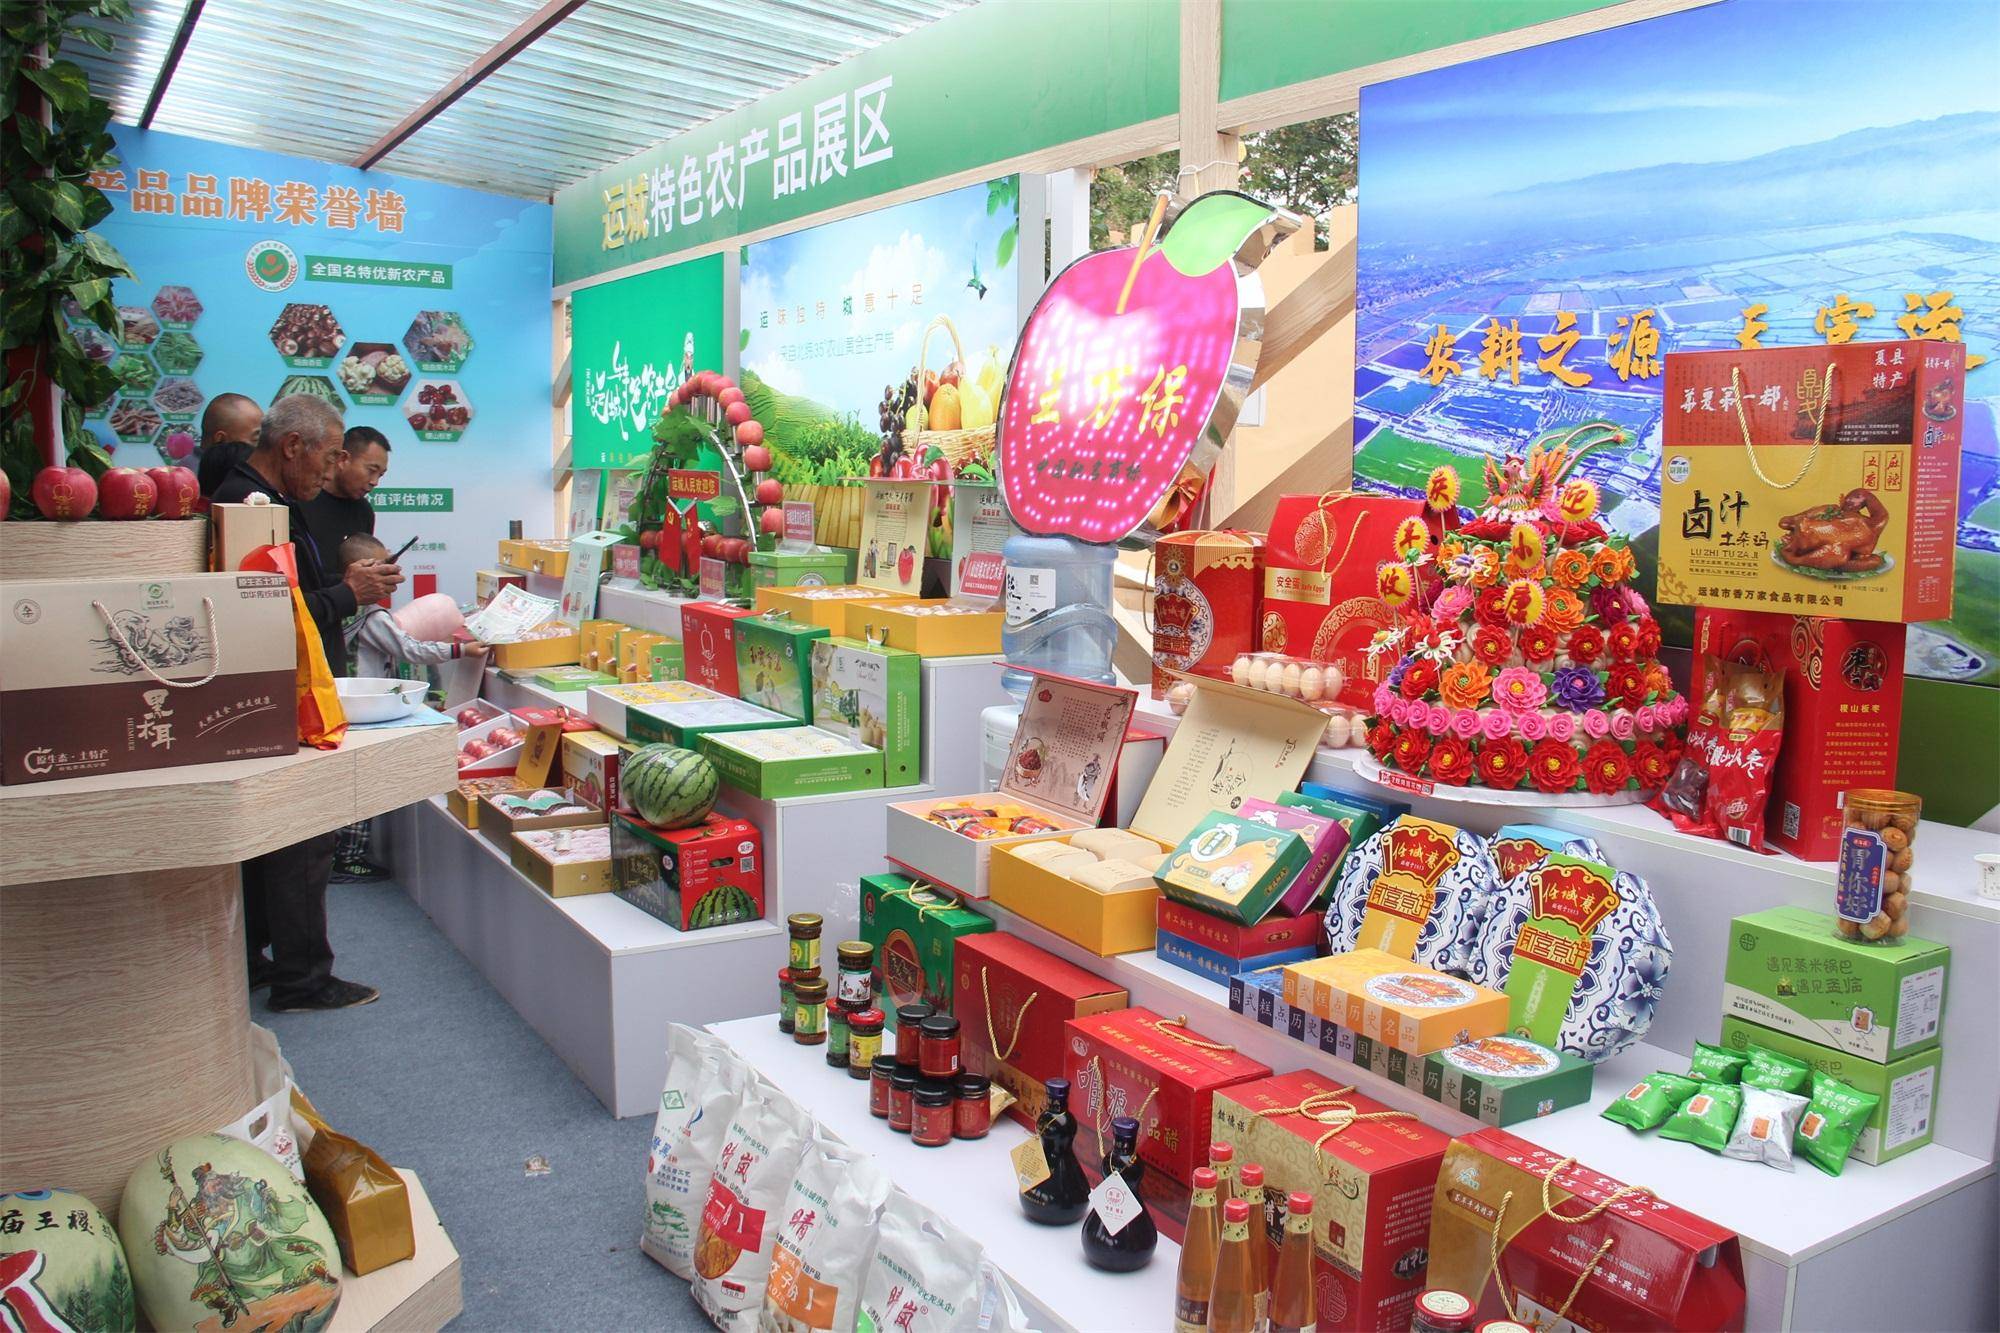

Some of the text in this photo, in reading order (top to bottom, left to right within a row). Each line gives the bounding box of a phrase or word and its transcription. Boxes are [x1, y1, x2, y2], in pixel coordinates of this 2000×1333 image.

[602, 75, 893, 250] 运城特色农产品展区
[311, 261, 446, 284] 全国名特优新农产品
[1419, 310, 1660, 387] 农耕之源
[1874, 348, 1905, 366] 夏县
[1873, 371, 1904, 389] 特产
[672, 476, 716, 494] 运城人民欢迎您
[1682, 490, 1749, 540] 卤汁
[1690, 548, 1701, 556] LU
[1703, 549, 1719, 557] ZHI
[1722, 550, 1735, 558] TU
[1751, 551, 1759, 559] JI
[1697, 586, 1843, 606] 运城市香万家食品有限公司
[1839, 704, 1881, 713] 稷山板枣
[1543, 881, 1596, 914] 任诚意
[1230, 985, 1352, 1051] 国式糕点历史名品
[1284, 978, 1416, 1043] 国式糕点历史名品
[1356, 1039, 1499, 1116] 国式糕点历史名品
